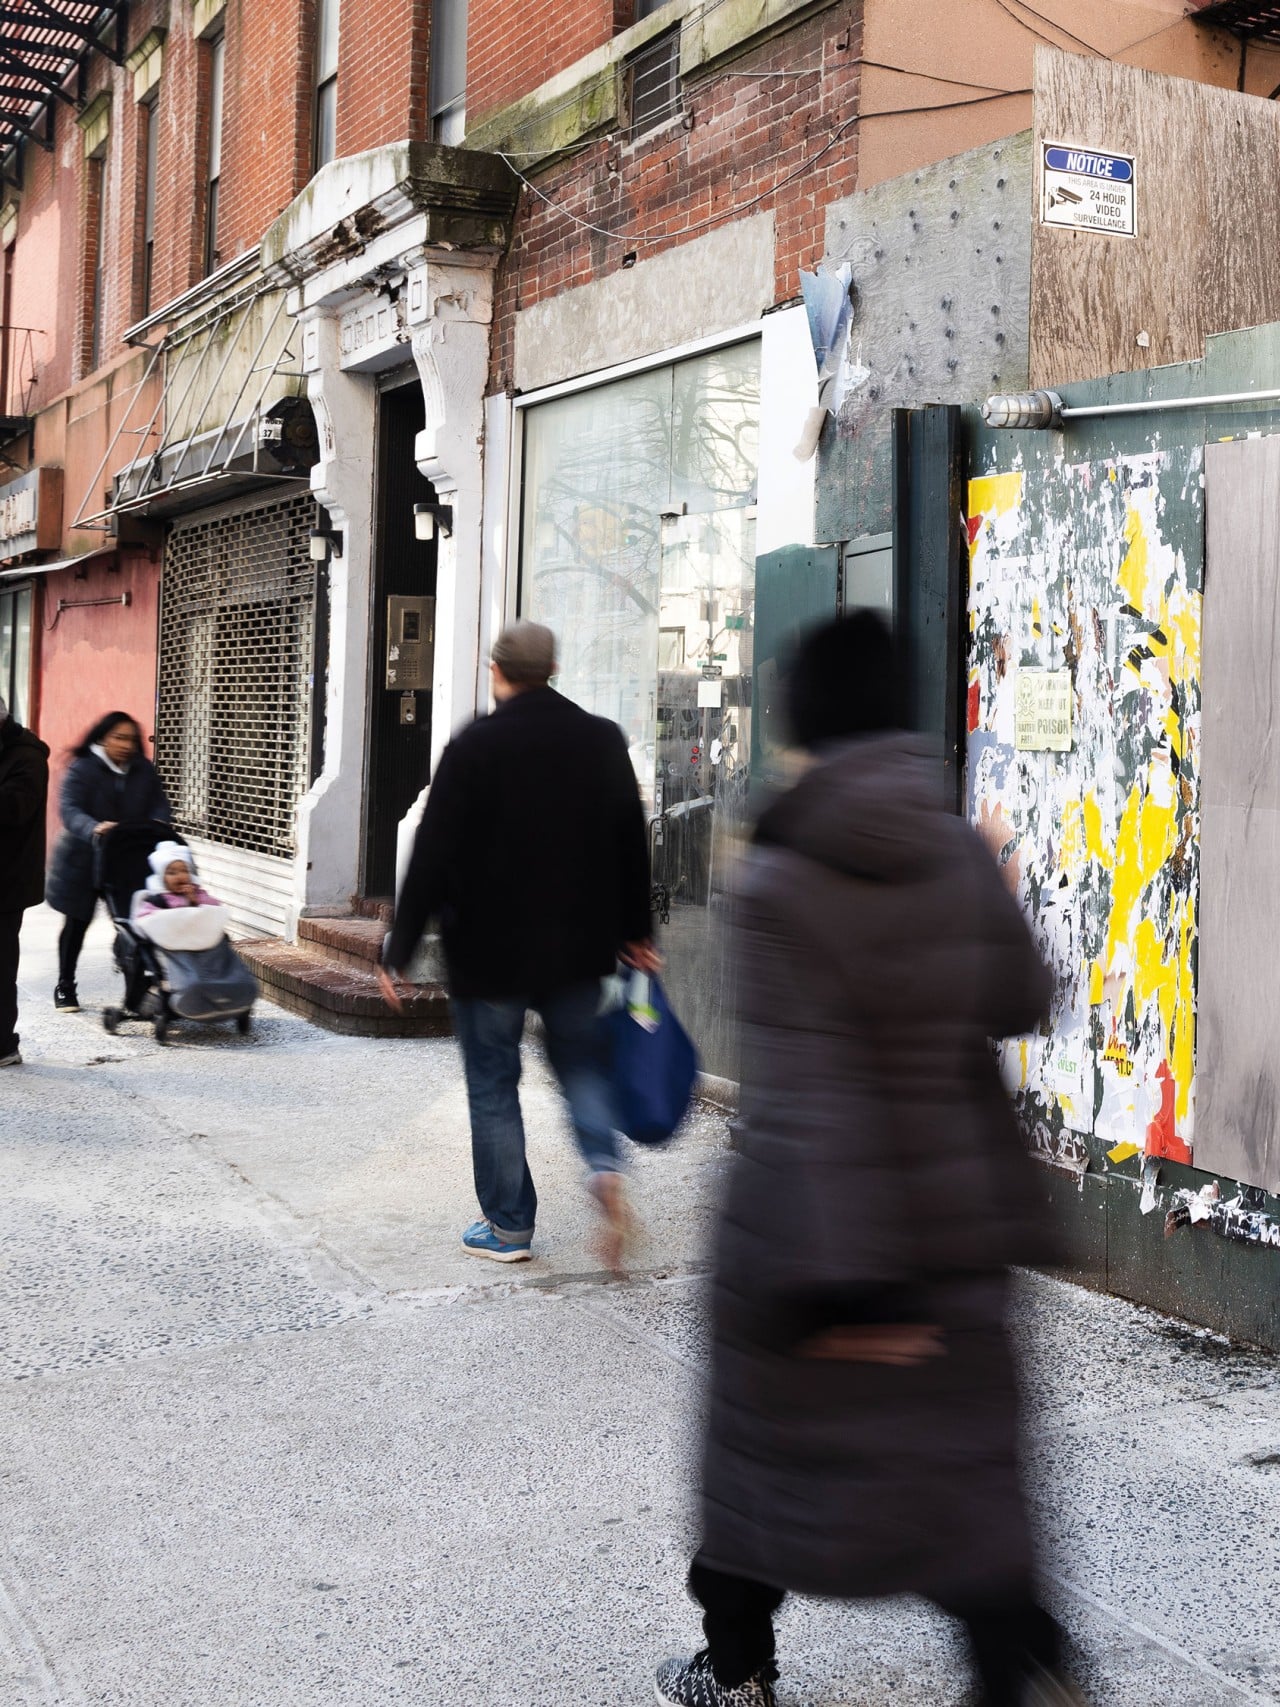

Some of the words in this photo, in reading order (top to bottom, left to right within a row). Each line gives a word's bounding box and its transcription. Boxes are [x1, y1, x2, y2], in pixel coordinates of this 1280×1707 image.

[1066, 153, 1113, 176] NOTICE
[1068, 176, 1081, 186] THIS
[1082, 179, 1098, 189] AREA
[1100, 182, 1106, 190] IS
[1107, 184, 1126, 193] UNDER
[1089, 190, 1100, 200] 24
[1103, 193, 1126, 206] HOUR
[1096, 203, 1121, 218] VIDEO
[1073, 212, 1126, 230] SURVEILLANCE
[1037, 719, 1069, 735] POISON
